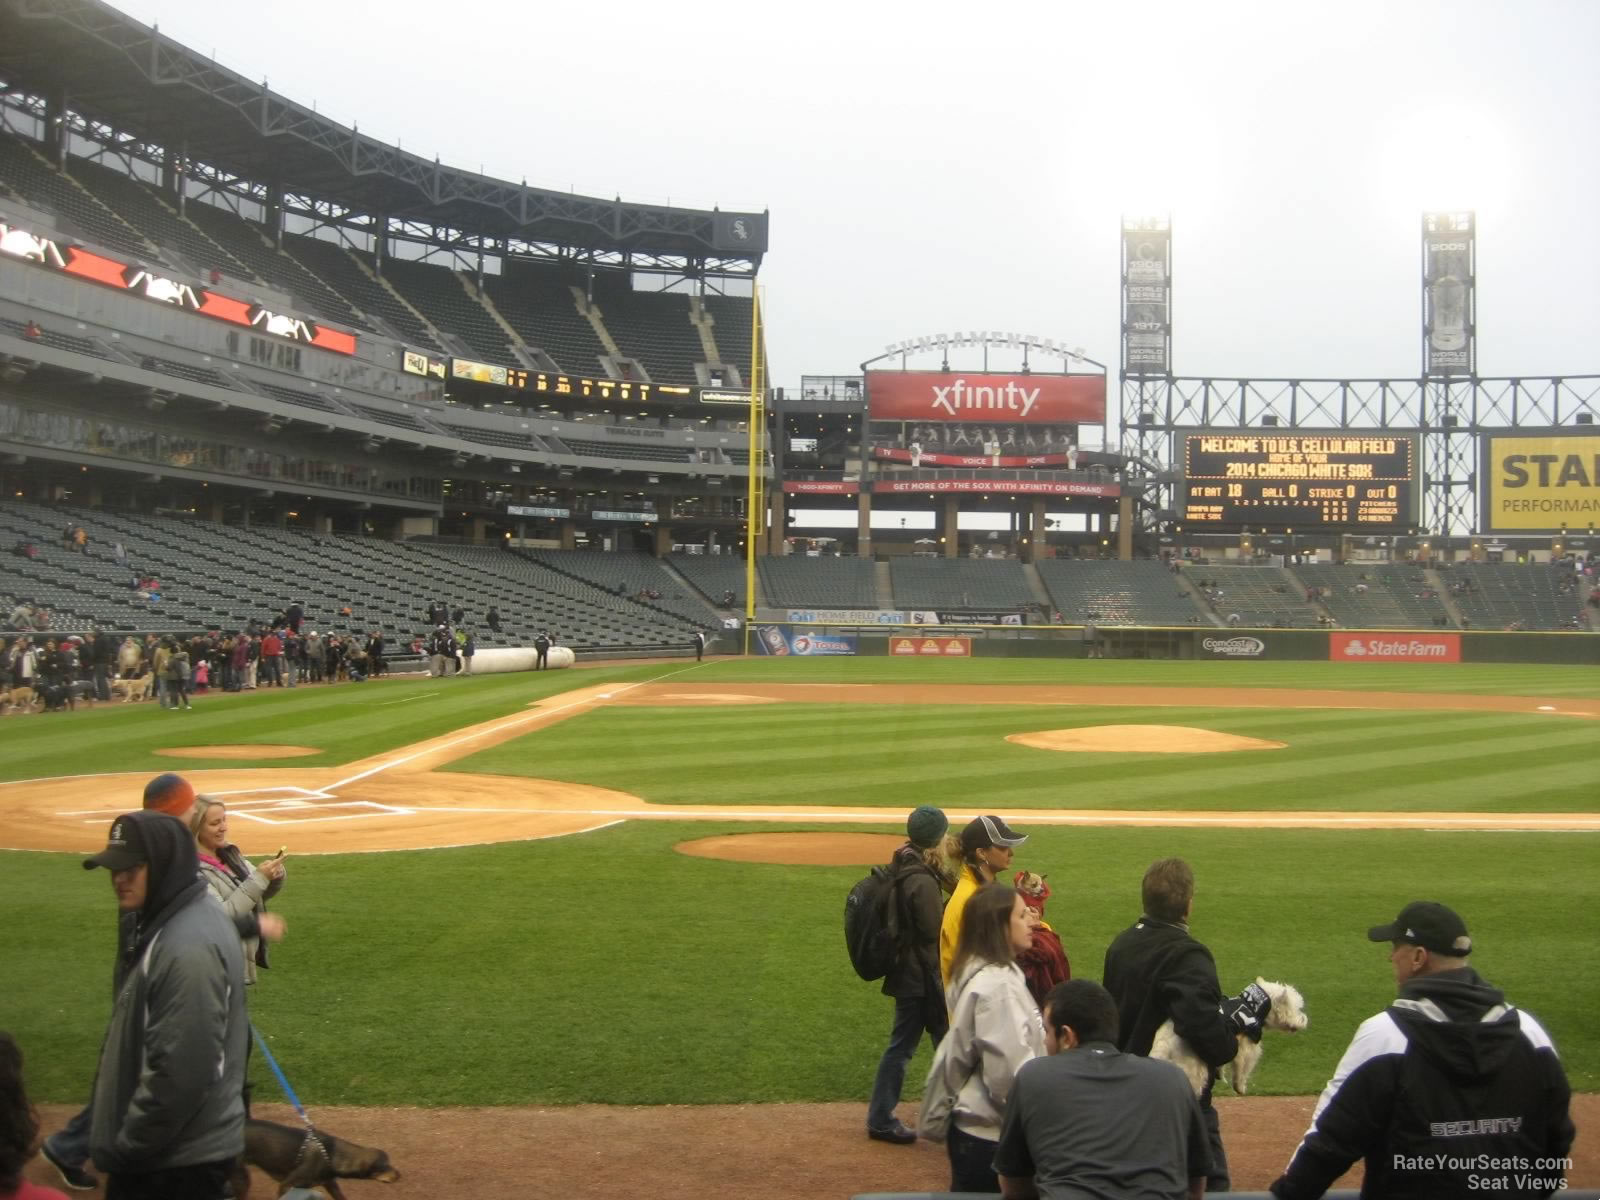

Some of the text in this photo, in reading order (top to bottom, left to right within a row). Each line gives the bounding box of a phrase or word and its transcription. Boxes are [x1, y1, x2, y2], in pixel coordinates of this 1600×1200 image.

[1431, 243, 1466, 251] 2005
[1133, 322, 1161, 330] 1917
[885, 331, 1086, 365] FUNDAMENTALS
[931, 379, 1041, 417] xfinity
[1201, 440, 1259, 453] WELCOME
[1261, 440, 1277, 453] TO
[1301, 440, 1361, 454] CELLULAR
[1362, 441, 1395, 454] FIELD
[962, 457, 987, 465] VOICE
[1269, 454, 1328, 463] HOME OF YOUR
[1226, 463, 1373, 477] 2014 CHICAGO WHITE SOX
[1502, 454, 1600, 489] STA
[972, 482, 991, 490] SOX
[1019, 483, 1052, 491] XFINITY
[1191, 483, 1397, 499] AT BAT 18 BALL 0 STRIKE 0 OUT 0
[816, 611, 844, 619] HOME
[1430, 1117, 1523, 1137] SECURITY
